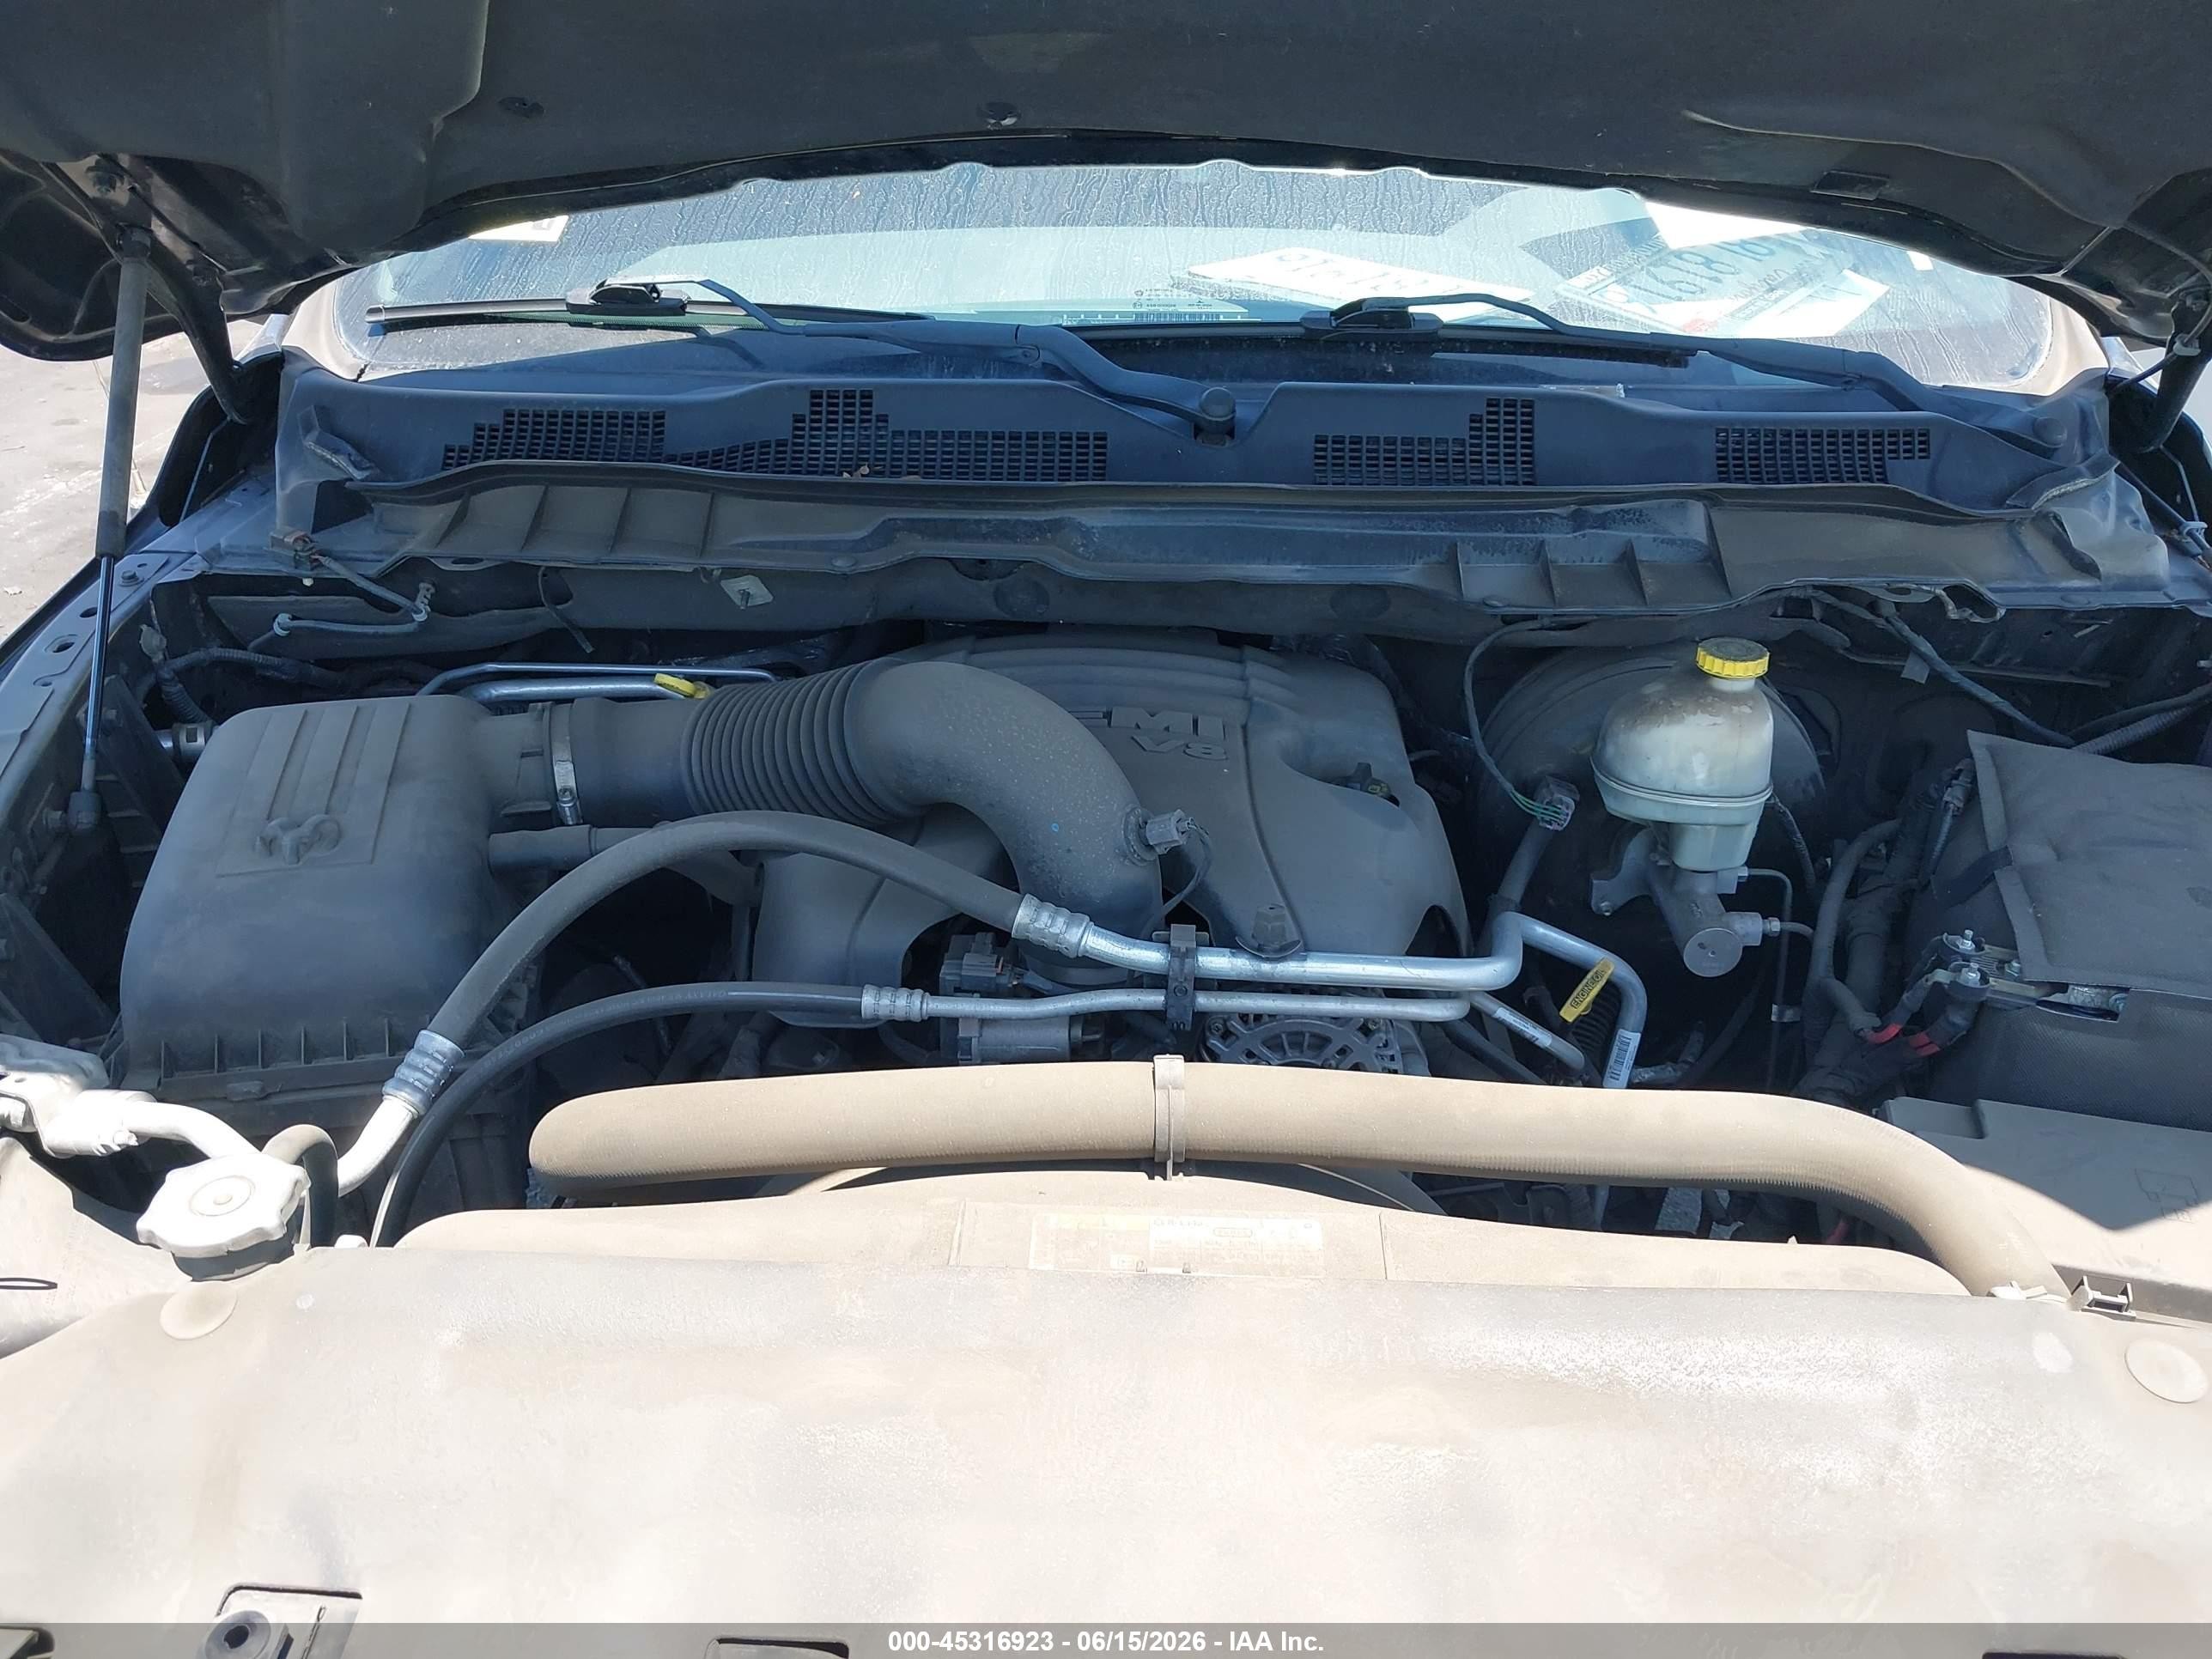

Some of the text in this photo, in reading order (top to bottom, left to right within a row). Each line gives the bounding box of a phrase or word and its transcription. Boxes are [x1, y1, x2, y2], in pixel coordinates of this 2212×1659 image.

[1131, 734, 1229, 761] V8
[1571, 969, 1607, 1009] ENGINE OIL
